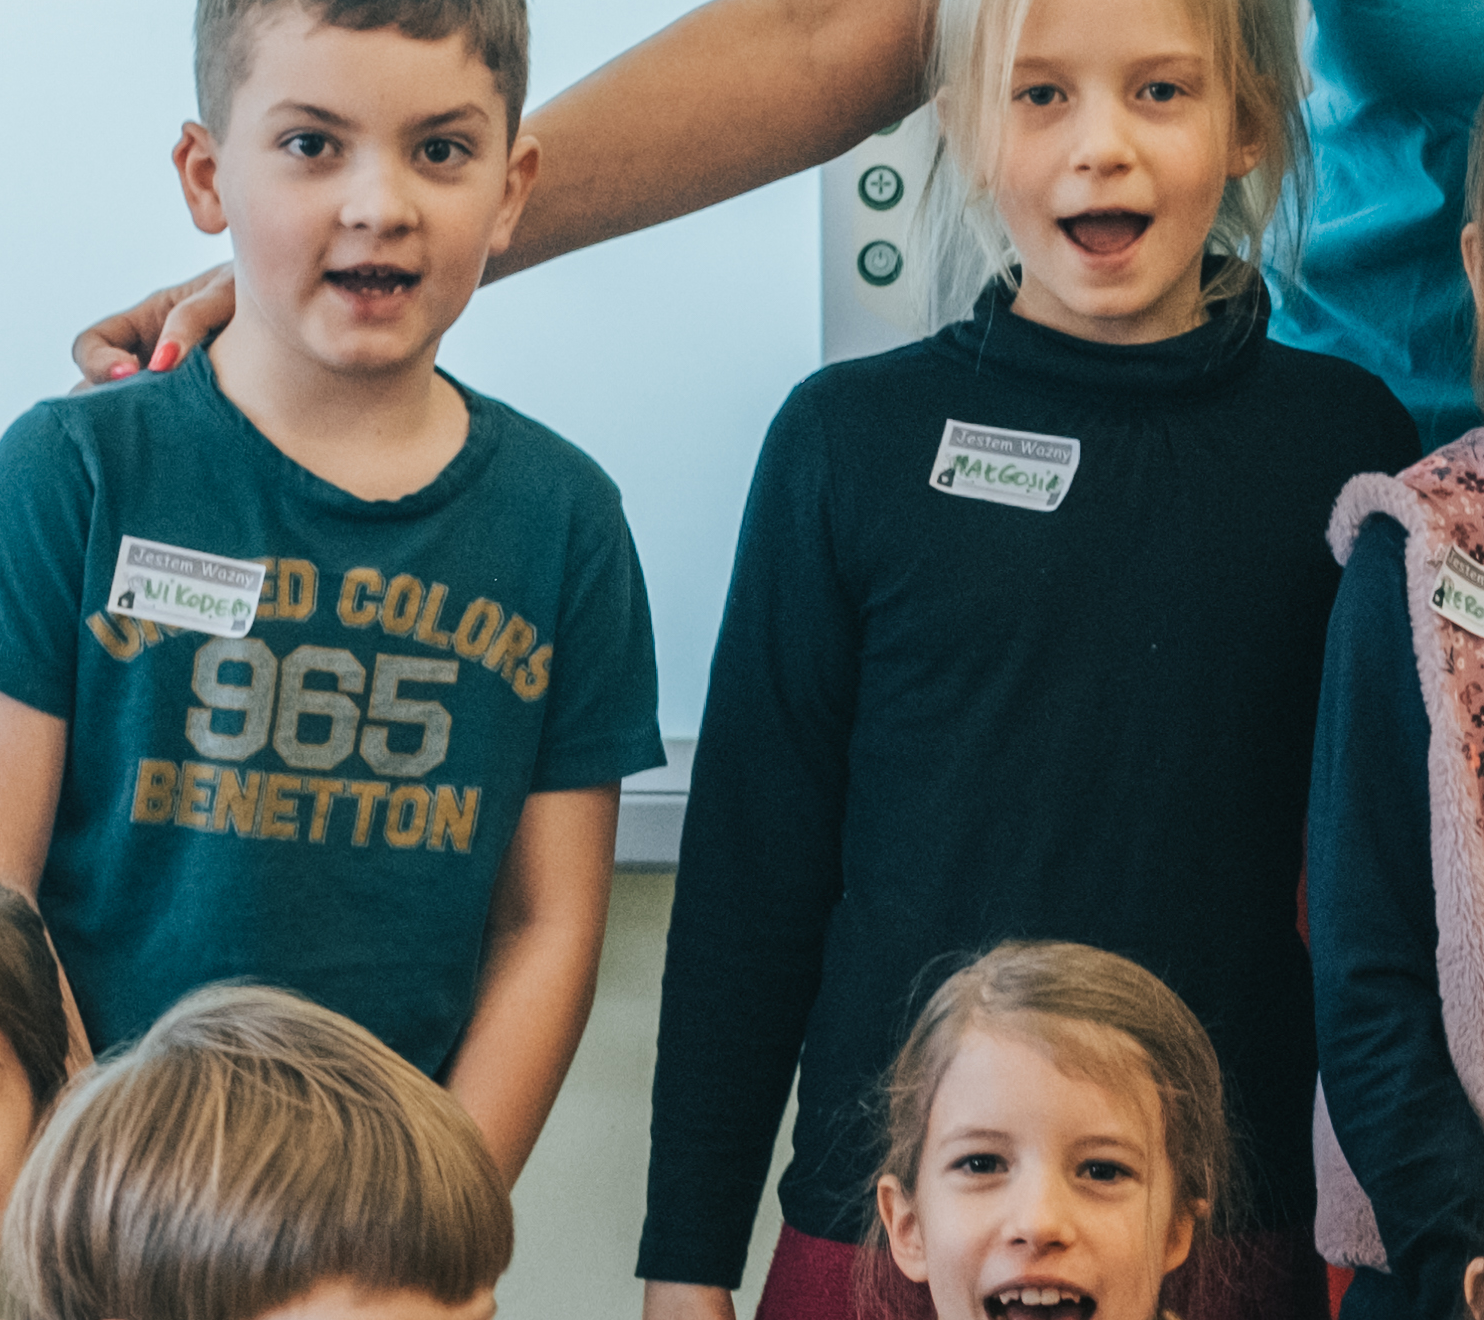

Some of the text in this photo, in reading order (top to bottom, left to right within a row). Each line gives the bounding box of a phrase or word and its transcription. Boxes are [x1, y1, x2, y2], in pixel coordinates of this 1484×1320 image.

[336, 565, 555, 703] COLORS
[183, 635, 460, 779] 965
[130, 756, 482, 855] BENETTON
